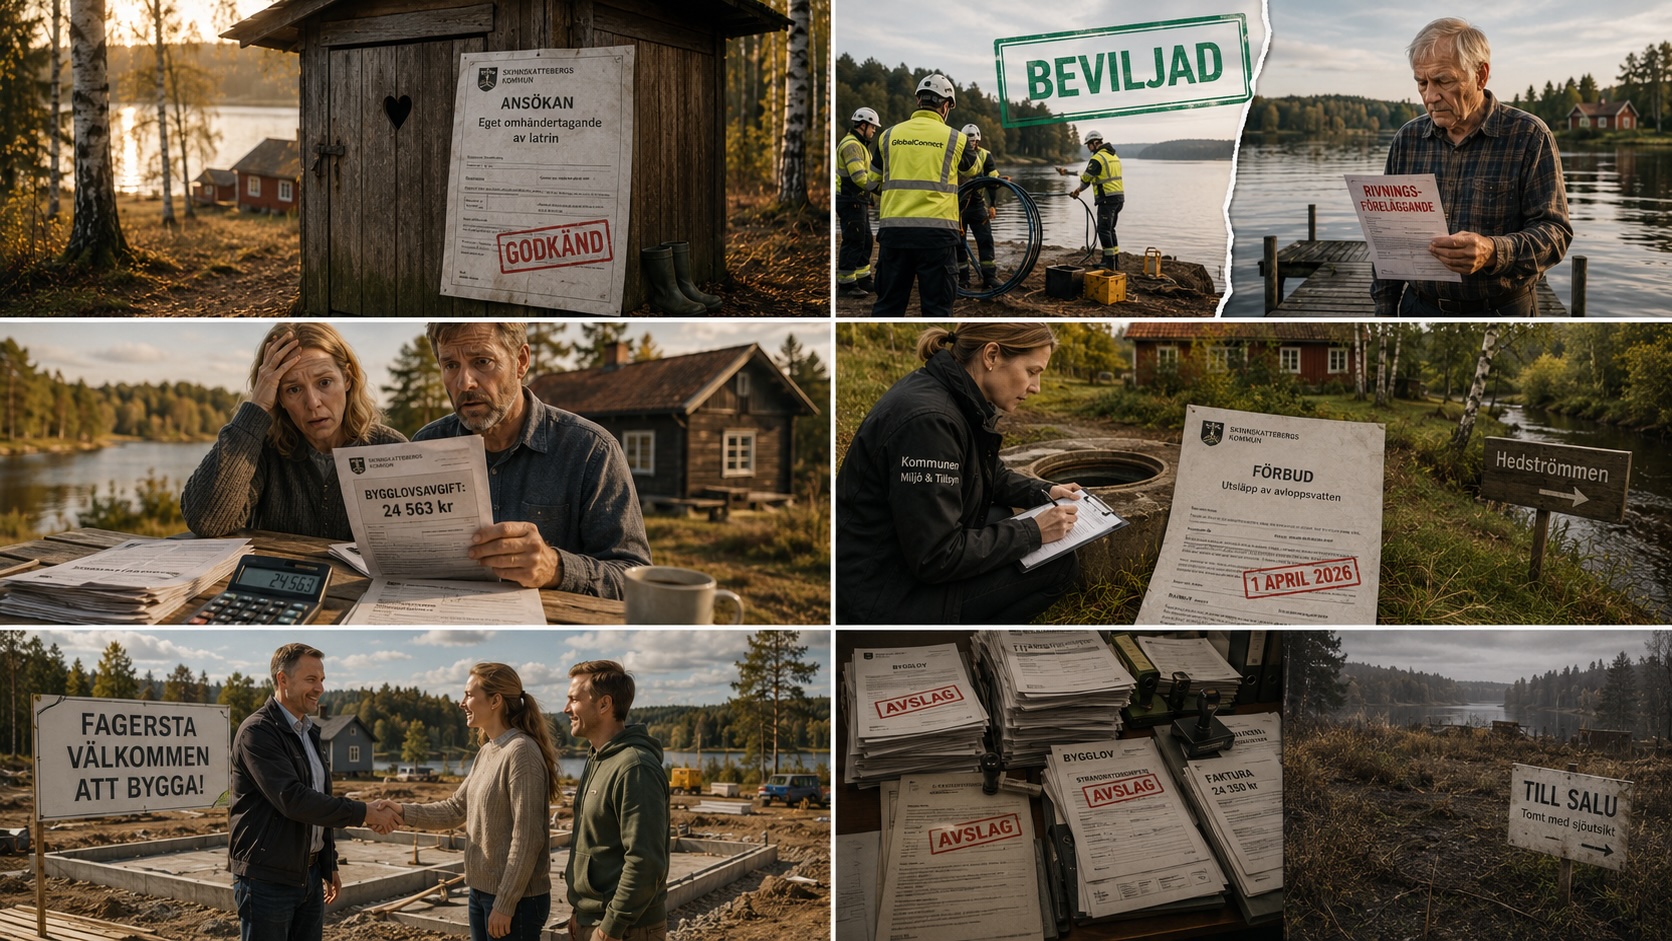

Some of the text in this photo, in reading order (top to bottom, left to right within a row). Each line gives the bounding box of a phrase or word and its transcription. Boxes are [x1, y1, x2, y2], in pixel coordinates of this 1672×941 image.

[501, 94, 574, 110] ANSÖKAN
[479, 117, 602, 129] Eget omhändertagande
[513, 133, 559, 143] av latrin
[891, 139, 944, 149] GlobalConnect
[1363, 185, 1422, 198] RIVNINGS-
[1360, 198, 1435, 213] FÖRELÄGGANDE
[505, 229, 604, 264] GODKÄND
[901, 456, 960, 471] Kommunen
[1252, 463, 1314, 483] FÖRBUD
[1496, 450, 1609, 483] Hedströmmen
[900, 472, 960, 486] Miljö & Tillsyn
[365, 482, 466, 500] BYGGLOVSAVGIFT:
[1221, 481, 1342, 502] Utsläpp av avloppsvatten
[382, 500, 454, 518] 24 563 kr
[1250, 577, 1260, 592] 1
[1264, 570, 1311, 591] APRIL
[1312, 565, 1352, 585] 2026
[886, 689, 955, 714] AVSLAG
[81, 712, 197, 737] FAGERSTA
[67, 740, 210, 768] VÄLKOMMEN
[1063, 749, 1115, 763] BYGGLOV
[1204, 769, 1255, 784] FAKTURA
[74, 774, 204, 802] ATT BYGGA!
[1093, 778, 1156, 803] AVSLAG
[1211, 786, 1227, 796] 24
[1523, 780, 1618, 818] TILL SALU
[1521, 808, 1617, 837] Tomt med sjöutsikt
[938, 819, 1013, 848] AVSLAG
